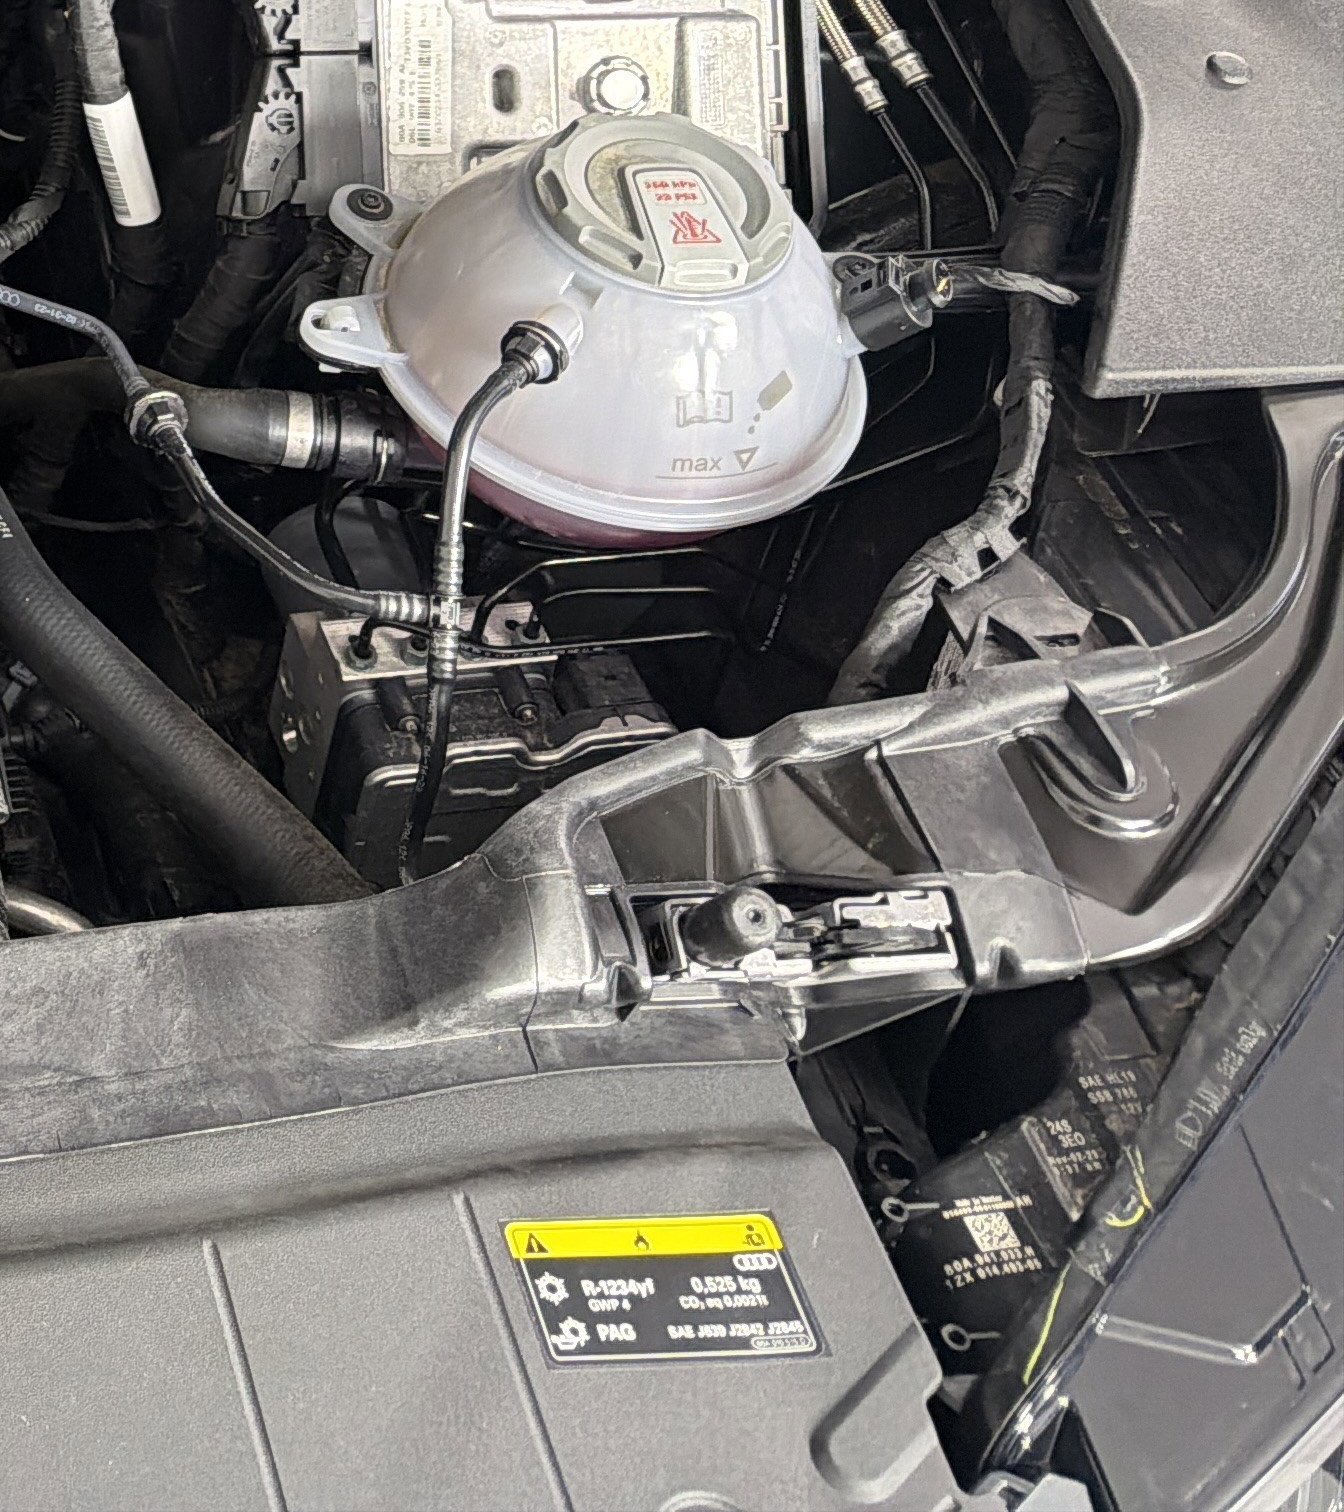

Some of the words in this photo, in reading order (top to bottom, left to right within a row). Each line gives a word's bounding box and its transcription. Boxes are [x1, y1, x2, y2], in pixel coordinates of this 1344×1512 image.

[671, 456, 724, 473] max
[1078, 1074, 1105, 1089] SAE
[580, 1277, 656, 1299] R-1234yf
[689, 1275, 737, 1295] 0,525
[737, 1274, 762, 1294] kg
[587, 1299, 620, 1313] GWP
[705, 1297, 724, 1311] eq
[596, 1322, 637, 1343] PAG
[667, 1324, 696, 1340] SAE
